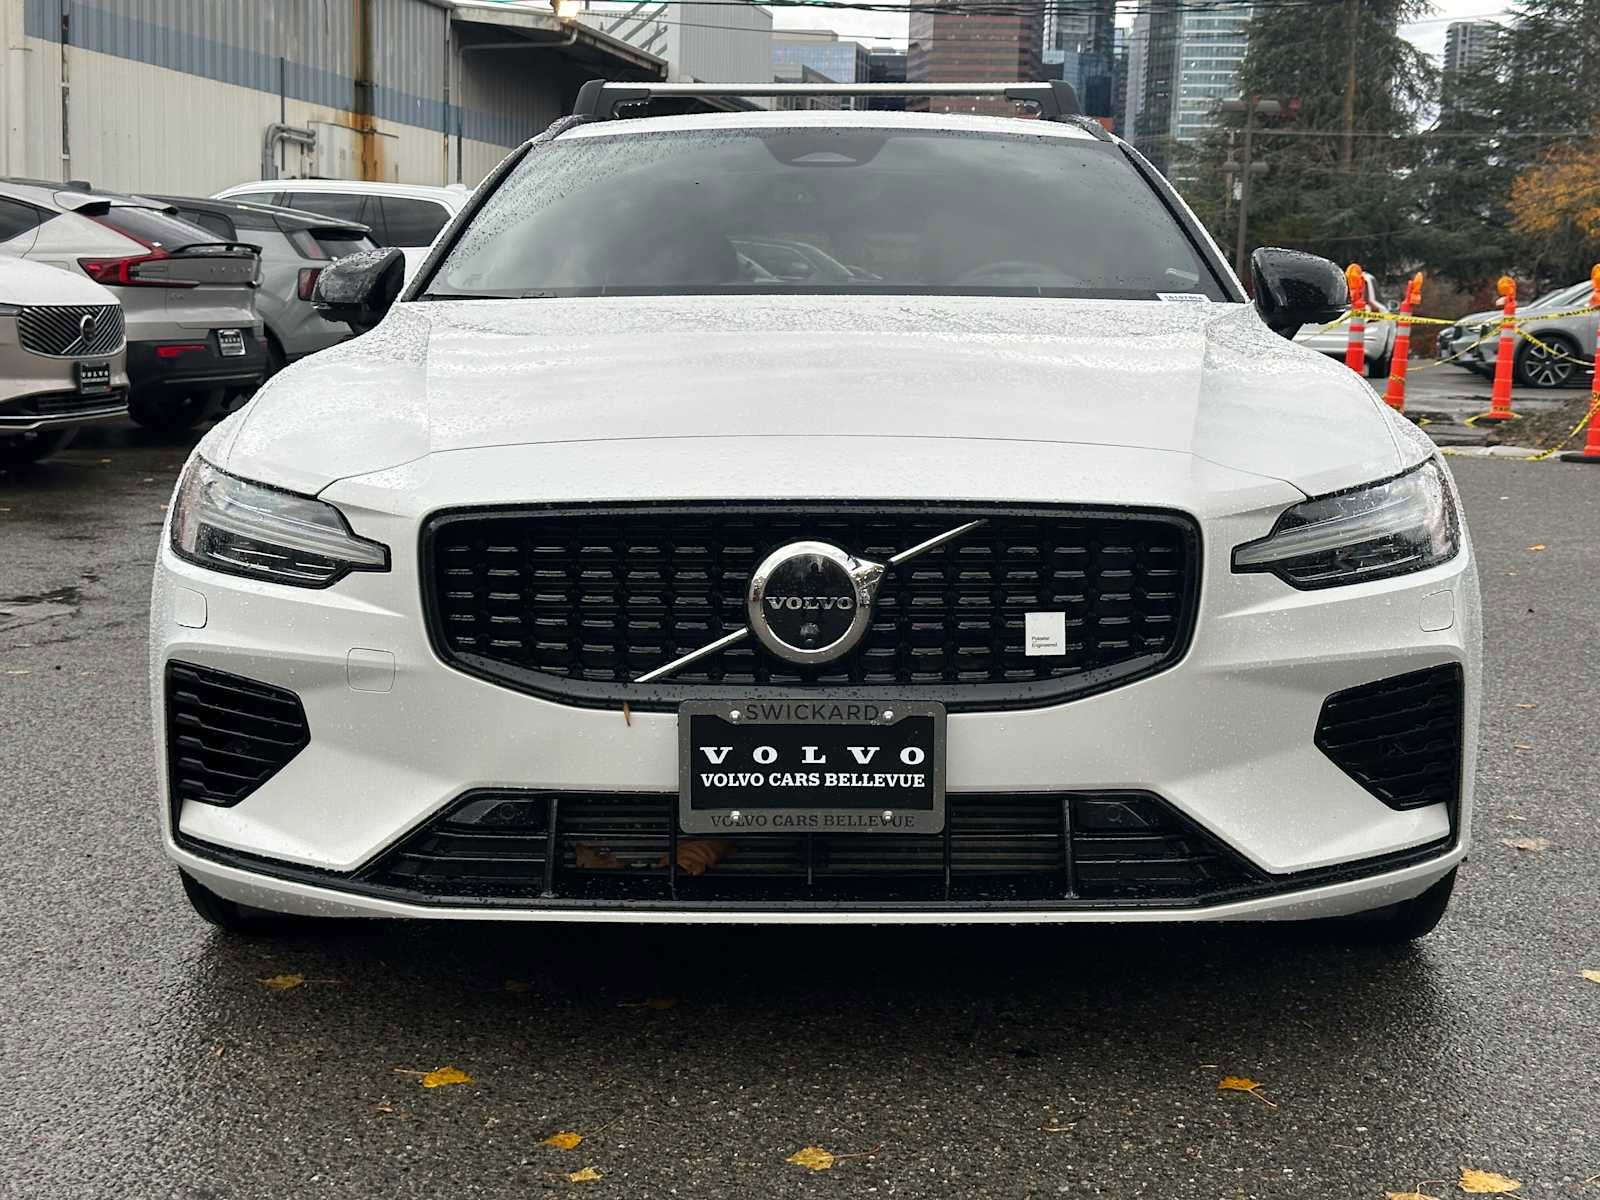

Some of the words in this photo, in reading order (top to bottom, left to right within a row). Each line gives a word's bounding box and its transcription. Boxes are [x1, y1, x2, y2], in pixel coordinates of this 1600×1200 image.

[765, 596, 854, 610] VOLVO
[746, 704, 880, 721] SWICKARD
[699, 746, 926, 765] VOLVO
[700, 772, 764, 787] VOLVO
[768, 772, 821, 787] CARS
[824, 773, 926, 788] BELLEVUE
[772, 814, 819, 828] CARS
